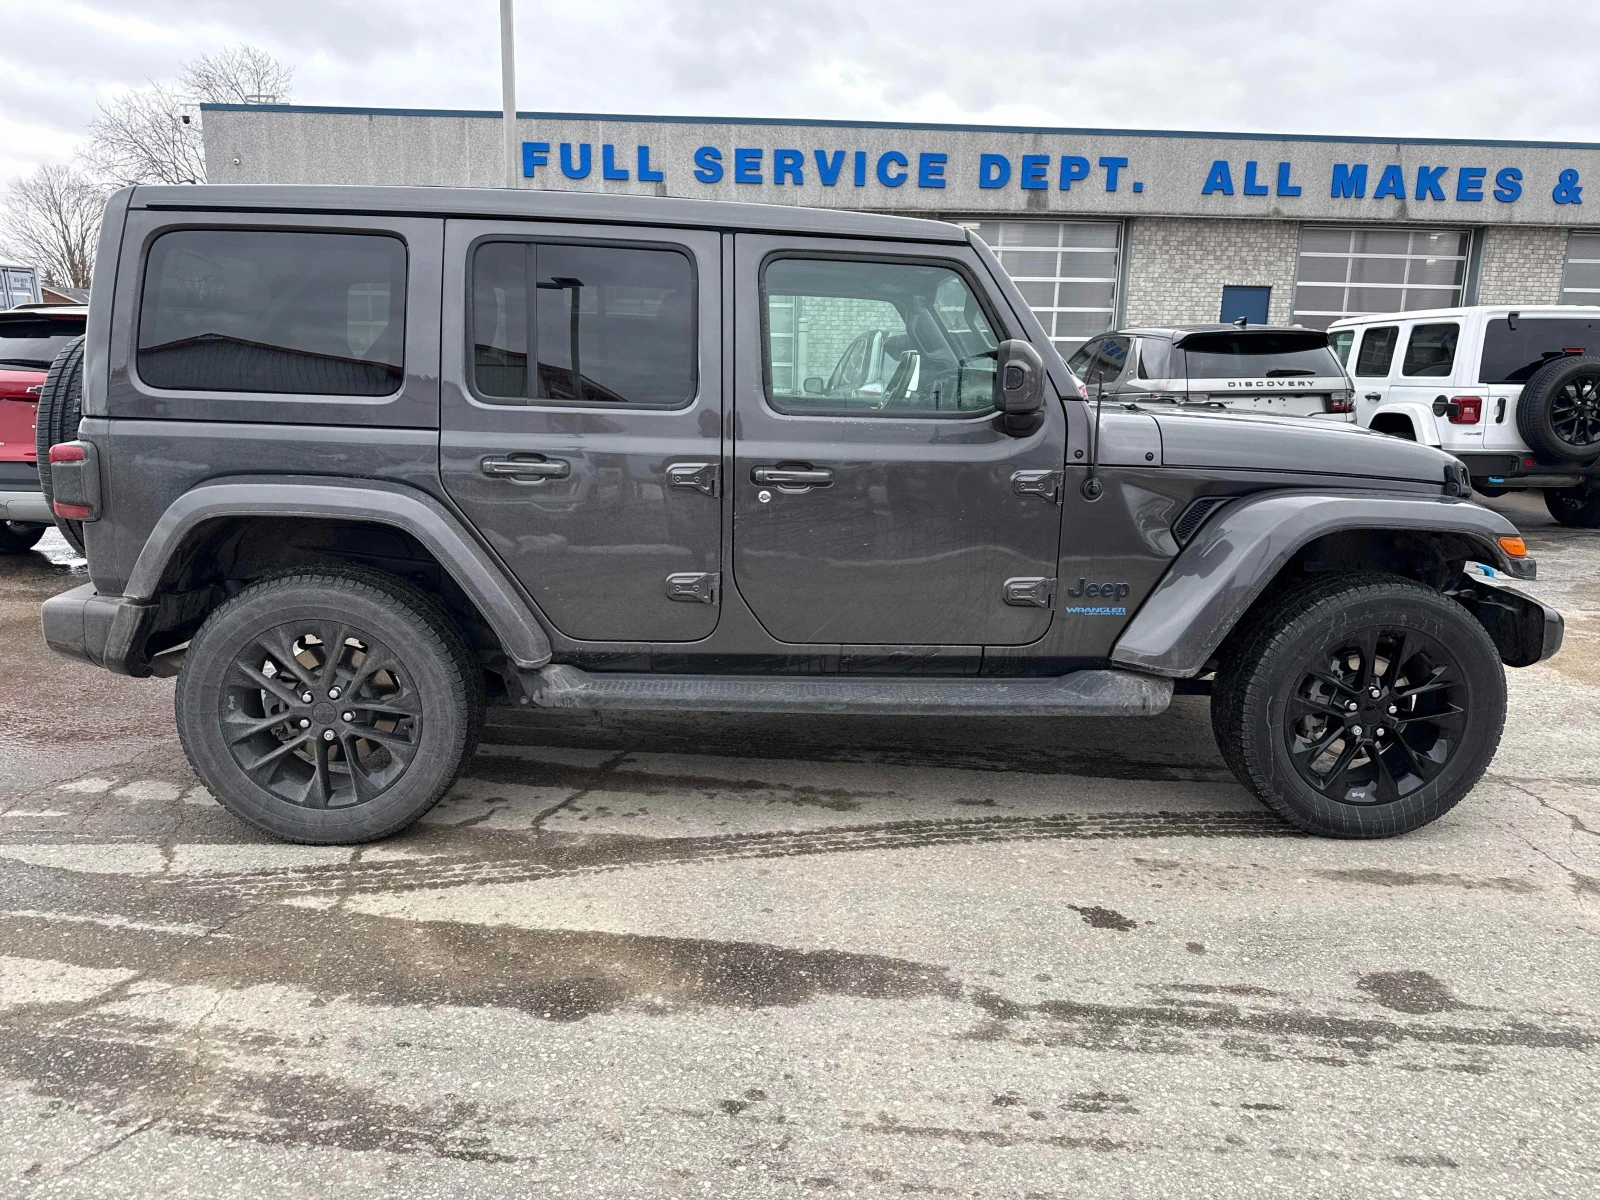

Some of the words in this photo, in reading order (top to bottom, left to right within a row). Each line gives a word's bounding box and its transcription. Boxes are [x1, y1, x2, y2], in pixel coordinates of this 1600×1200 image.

[522, 141, 664, 182] FULL
[694, 146, 948, 189] SERVICE
[979, 153, 1143, 193] DEPT.
[1202, 160, 1302, 197] ALL
[1330, 163, 1523, 203] MAKES
[1552, 168, 1583, 205] &
[1067, 577, 1130, 602] Jeep
